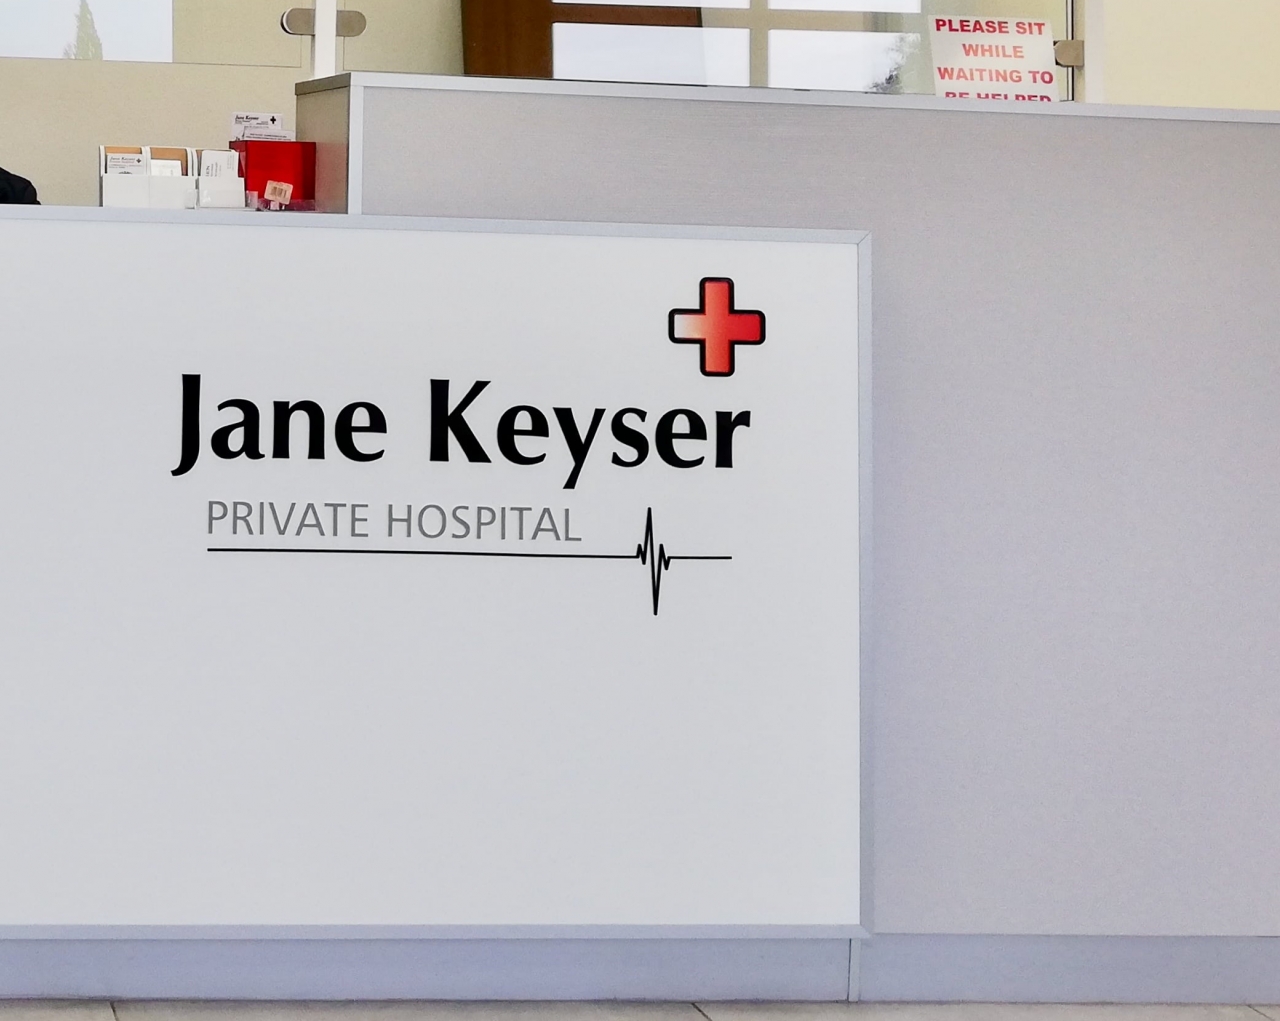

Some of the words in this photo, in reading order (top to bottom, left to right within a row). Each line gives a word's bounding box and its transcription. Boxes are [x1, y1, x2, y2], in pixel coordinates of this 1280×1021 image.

[935, 18, 1009, 34] PLEASE
[1015, 21, 1045, 35] SIT
[962, 43, 1024, 58] WHILE
[937, 66, 1022, 83] WAITING
[1028, 70, 1054, 84] TO
[171, 373, 387, 477] Jane
[428, 378, 751, 490] Keyser
[206, 500, 370, 538] PRIVATE
[386, 503, 582, 542] HOSPITAL
